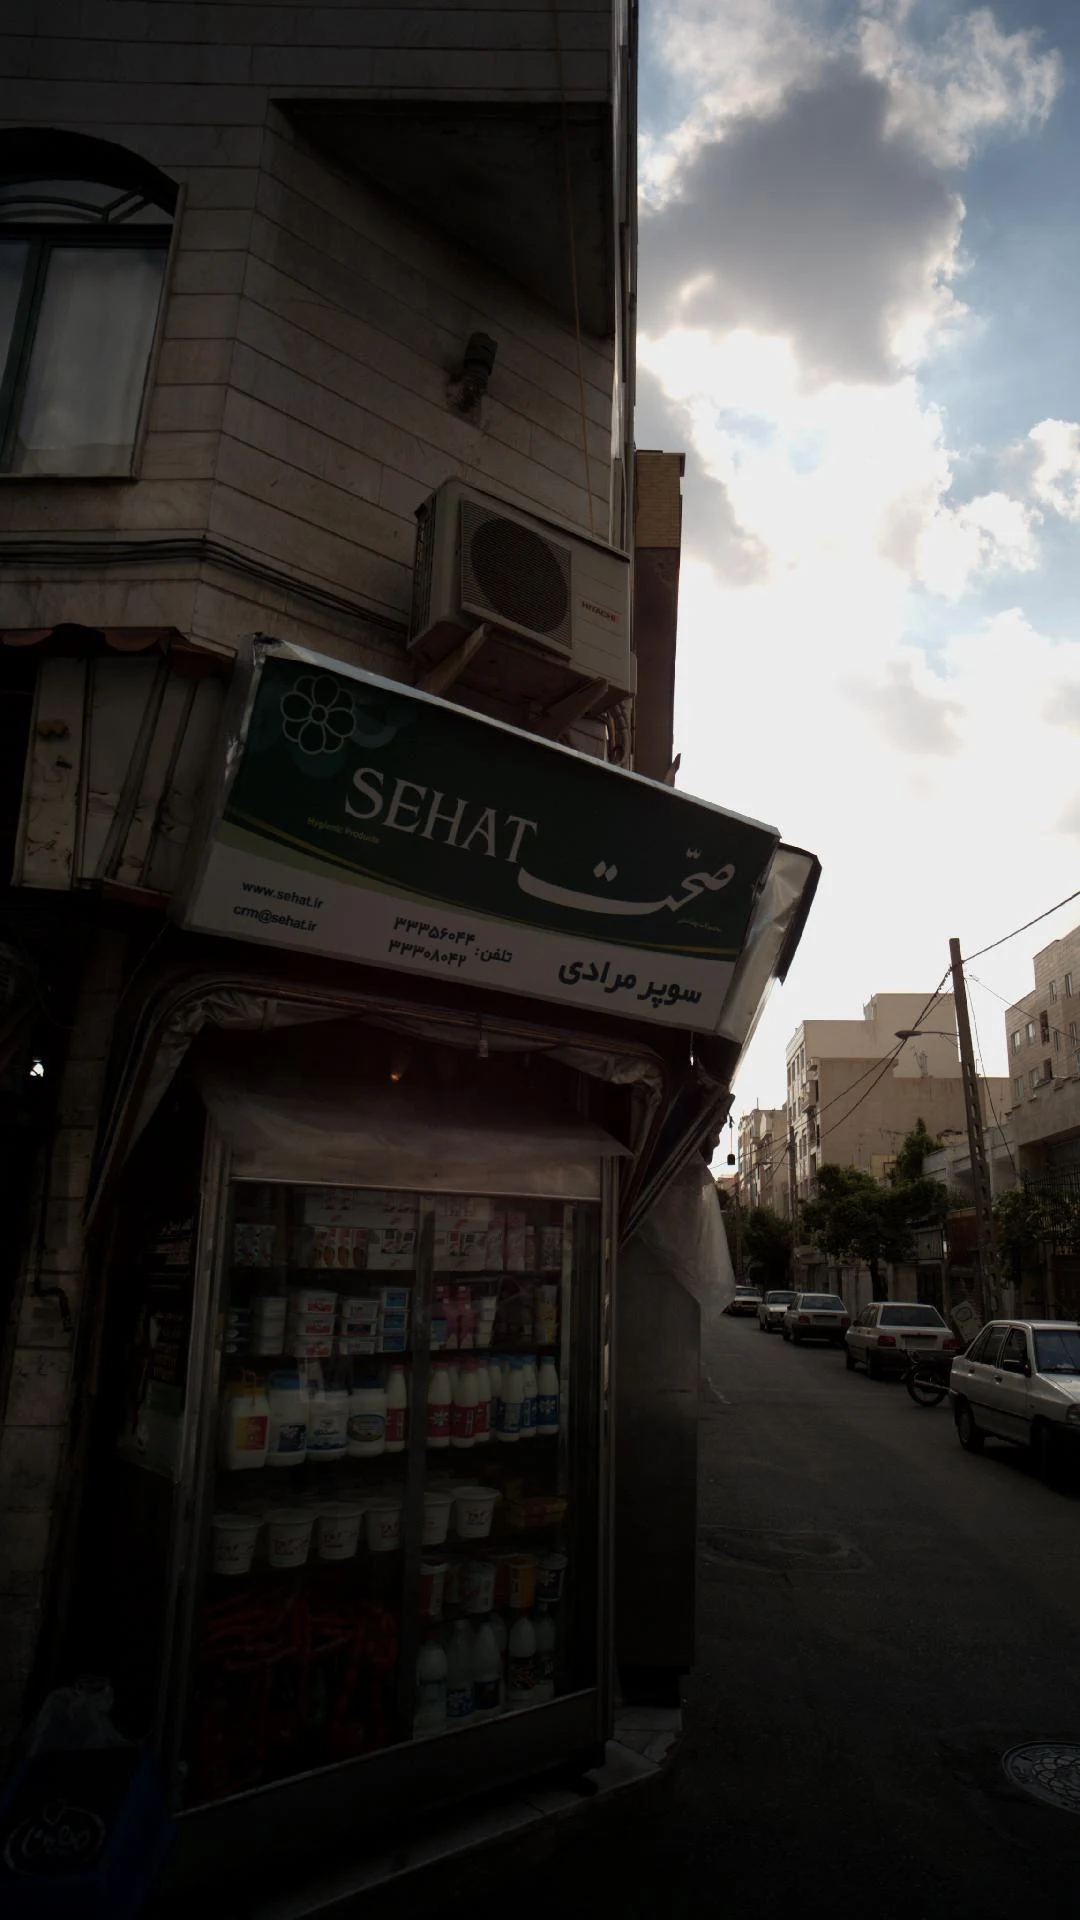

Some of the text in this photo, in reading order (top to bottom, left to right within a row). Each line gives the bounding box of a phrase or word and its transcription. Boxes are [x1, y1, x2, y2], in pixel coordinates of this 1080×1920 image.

[344, 767, 538, 864] SEHAT
[242, 881, 324, 909] www.sehat.ir
[233, 905, 317, 932] crm@sehat.ir
[558, 961, 702, 1008] سوپر مرادی
